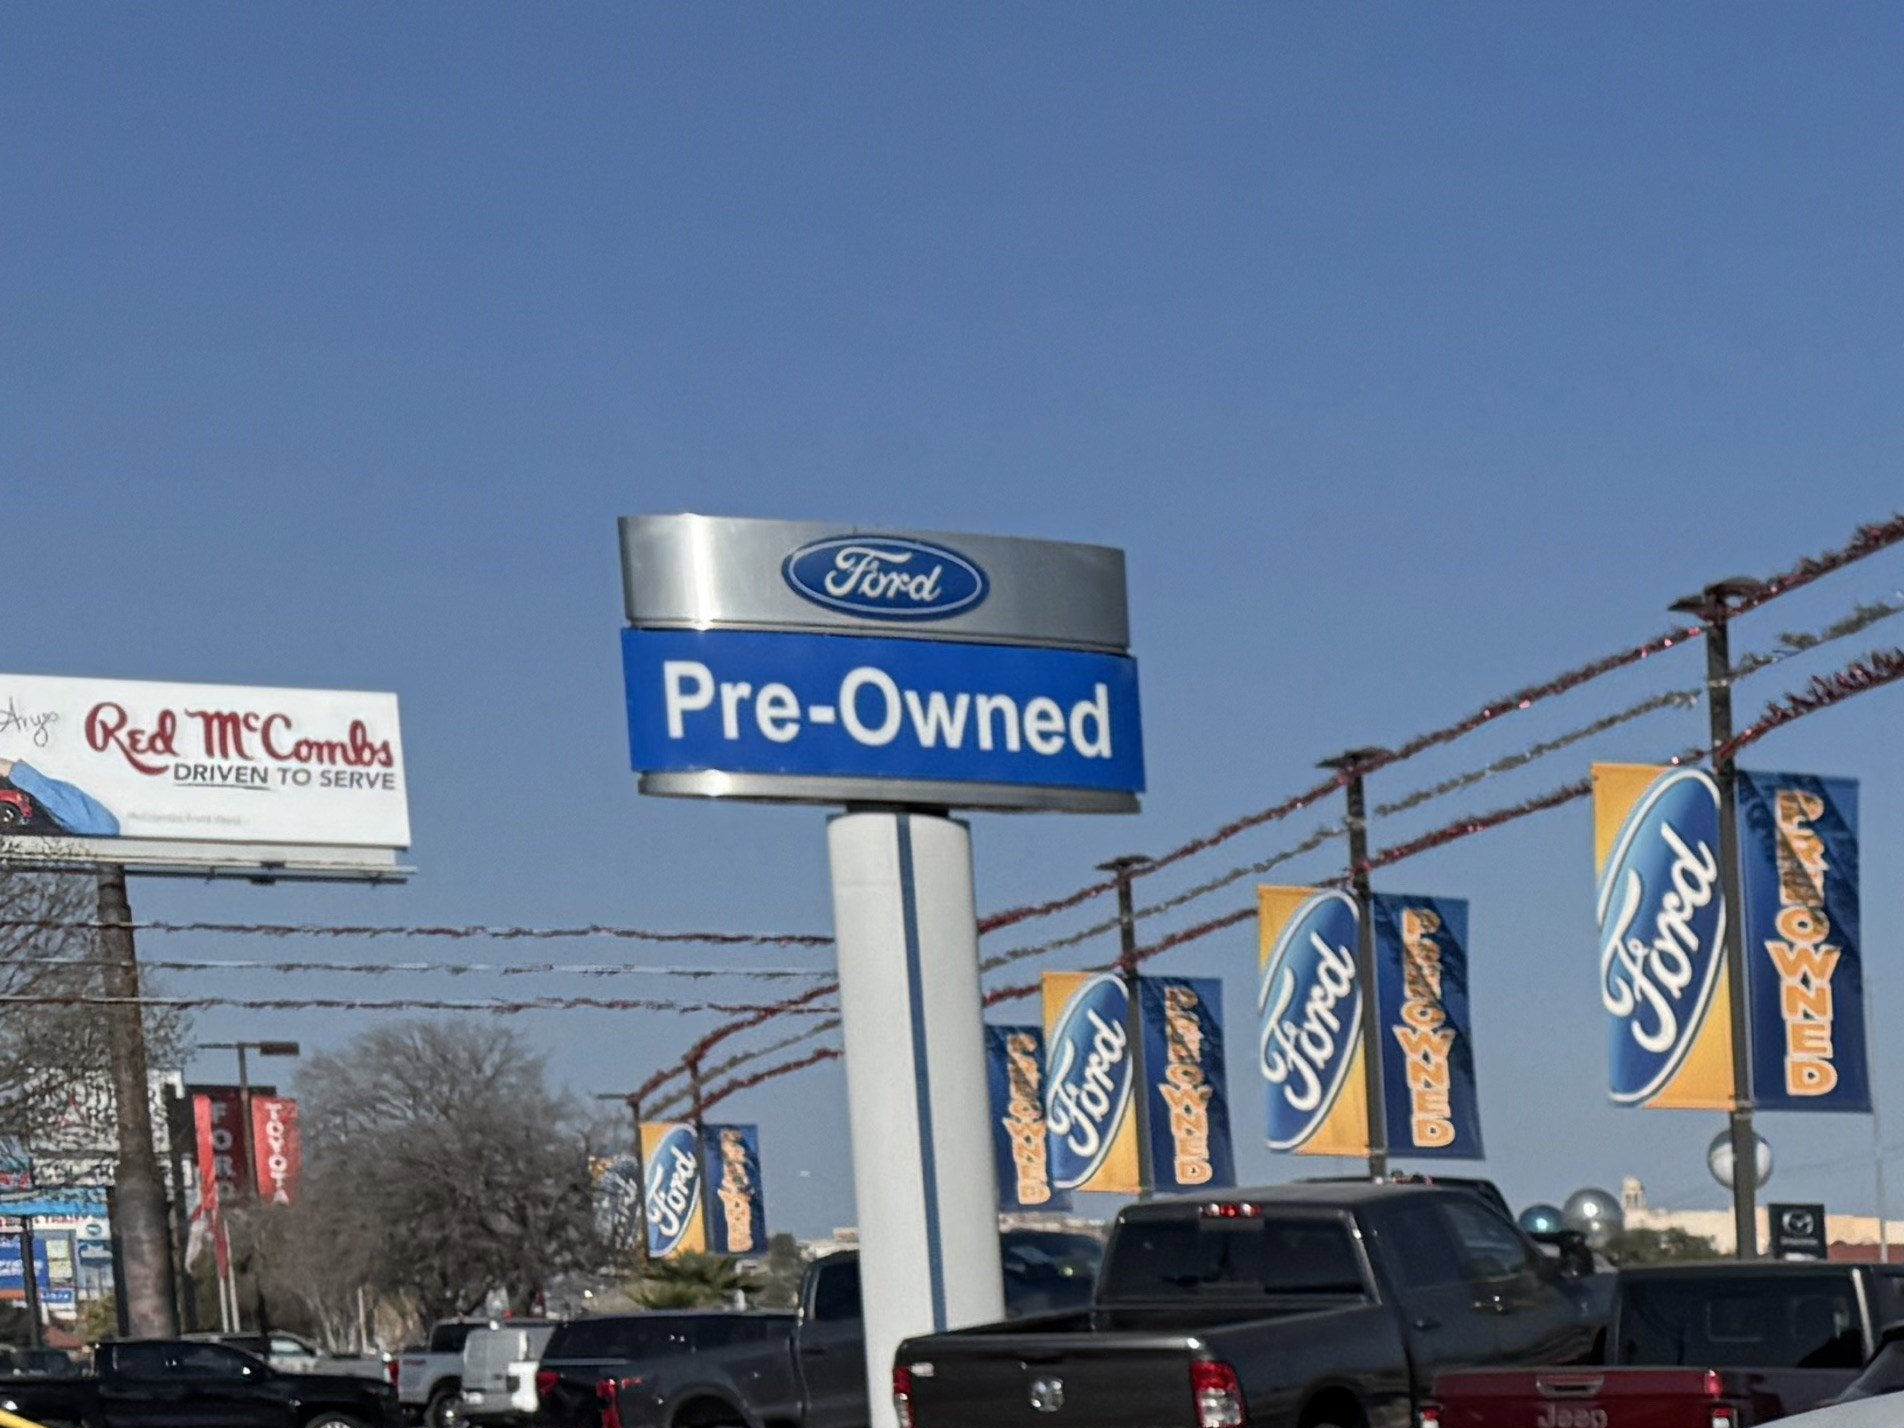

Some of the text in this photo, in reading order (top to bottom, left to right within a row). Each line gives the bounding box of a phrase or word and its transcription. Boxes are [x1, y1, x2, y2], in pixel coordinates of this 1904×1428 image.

[823, 546, 942, 602] Ford
[84, 701, 180, 776] Red
[184, 708, 394, 768] McCombs
[662, 660, 1113, 760] Pre-Owned
[173, 763, 396, 790] DRIVEN TO SERVE
[1602, 821, 1718, 1053] Ford
[1261, 931, 1356, 1111] Ford
[1046, 1008, 1126, 1158] Ford
[648, 1145, 697, 1237] Ford
